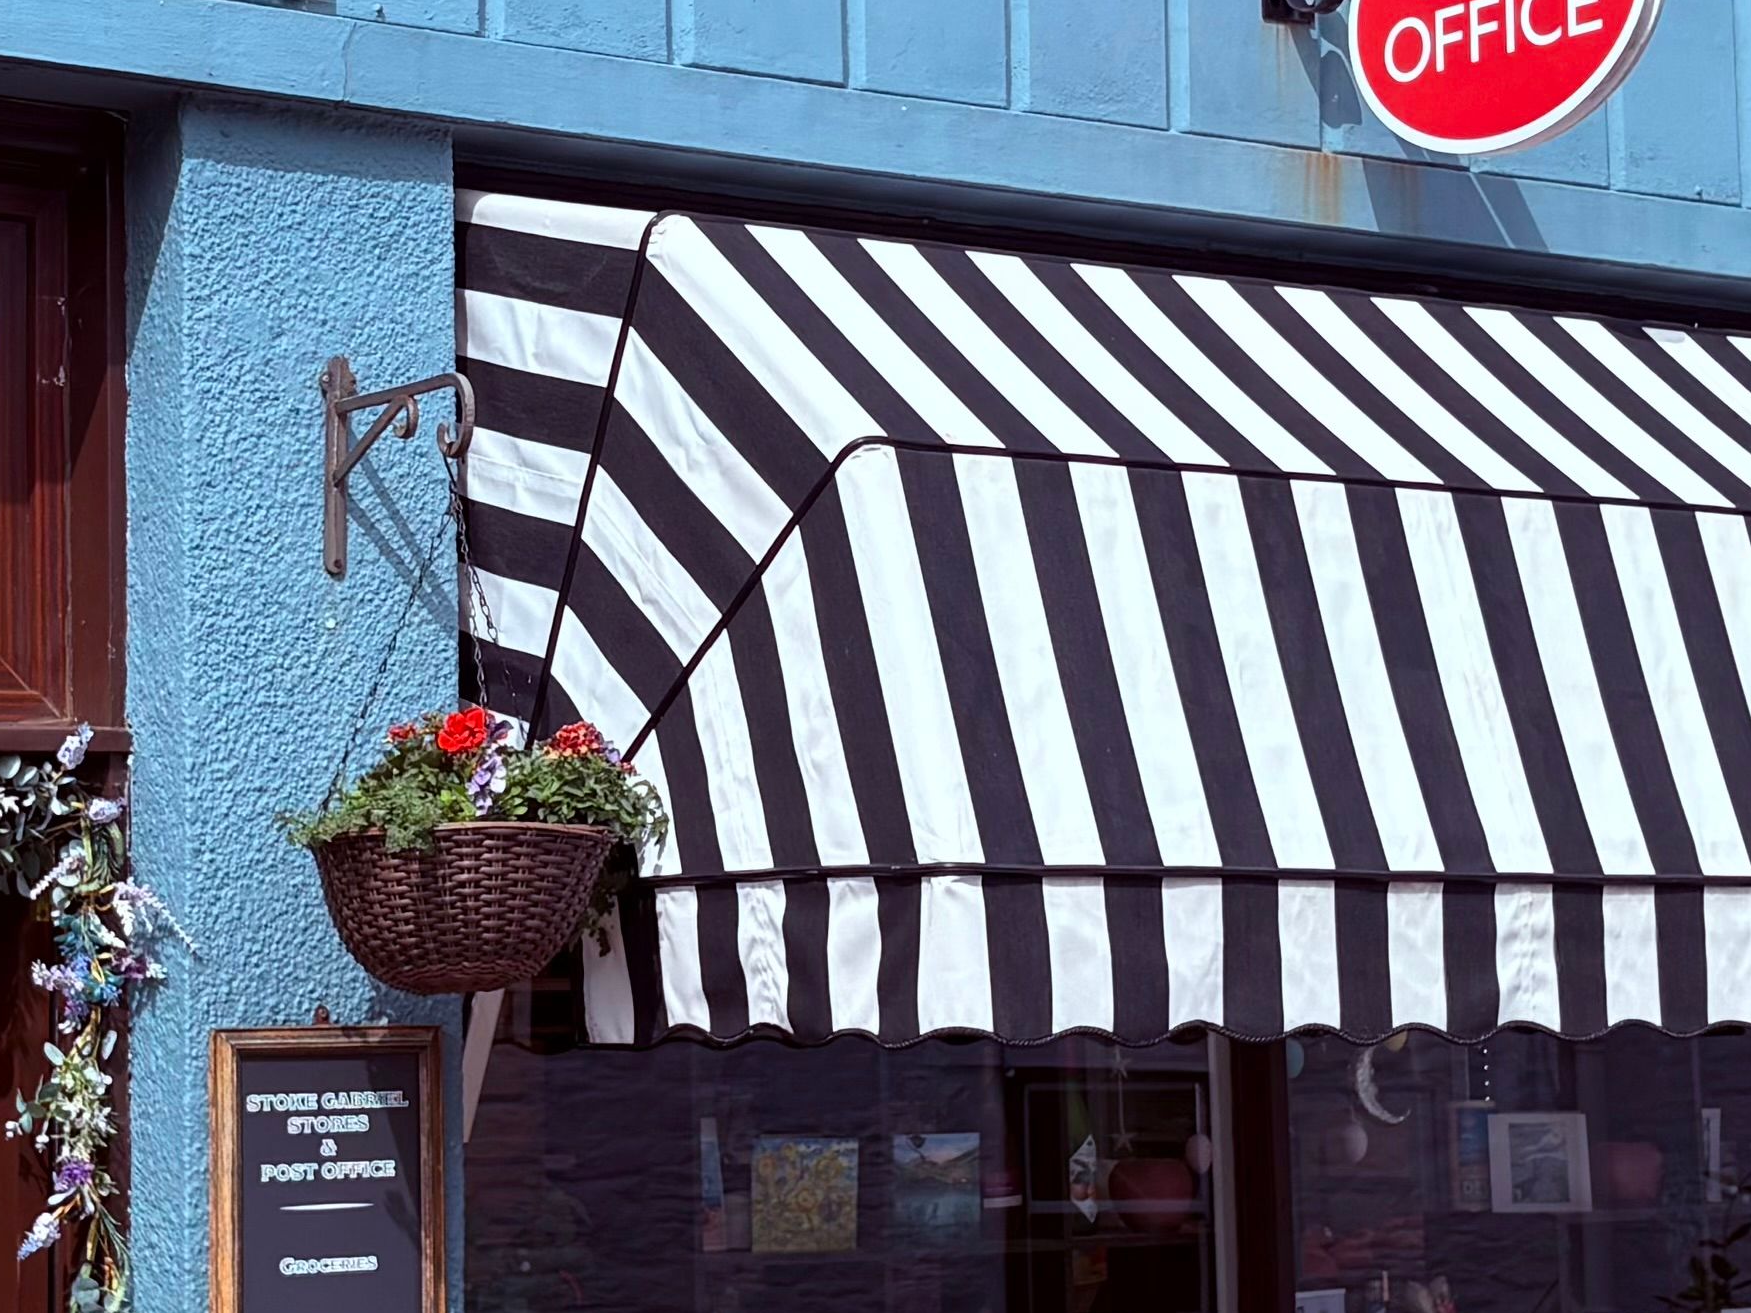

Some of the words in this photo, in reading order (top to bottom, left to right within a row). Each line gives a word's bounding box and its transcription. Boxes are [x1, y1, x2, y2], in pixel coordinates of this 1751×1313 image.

[246, 1093, 318, 1113] STOKE
[321, 1091, 409, 1110] GABRIEL
[287, 1114, 369, 1135] STORES
[261, 1162, 318, 1182] POST
[321, 1160, 395, 1180] OFFICE
